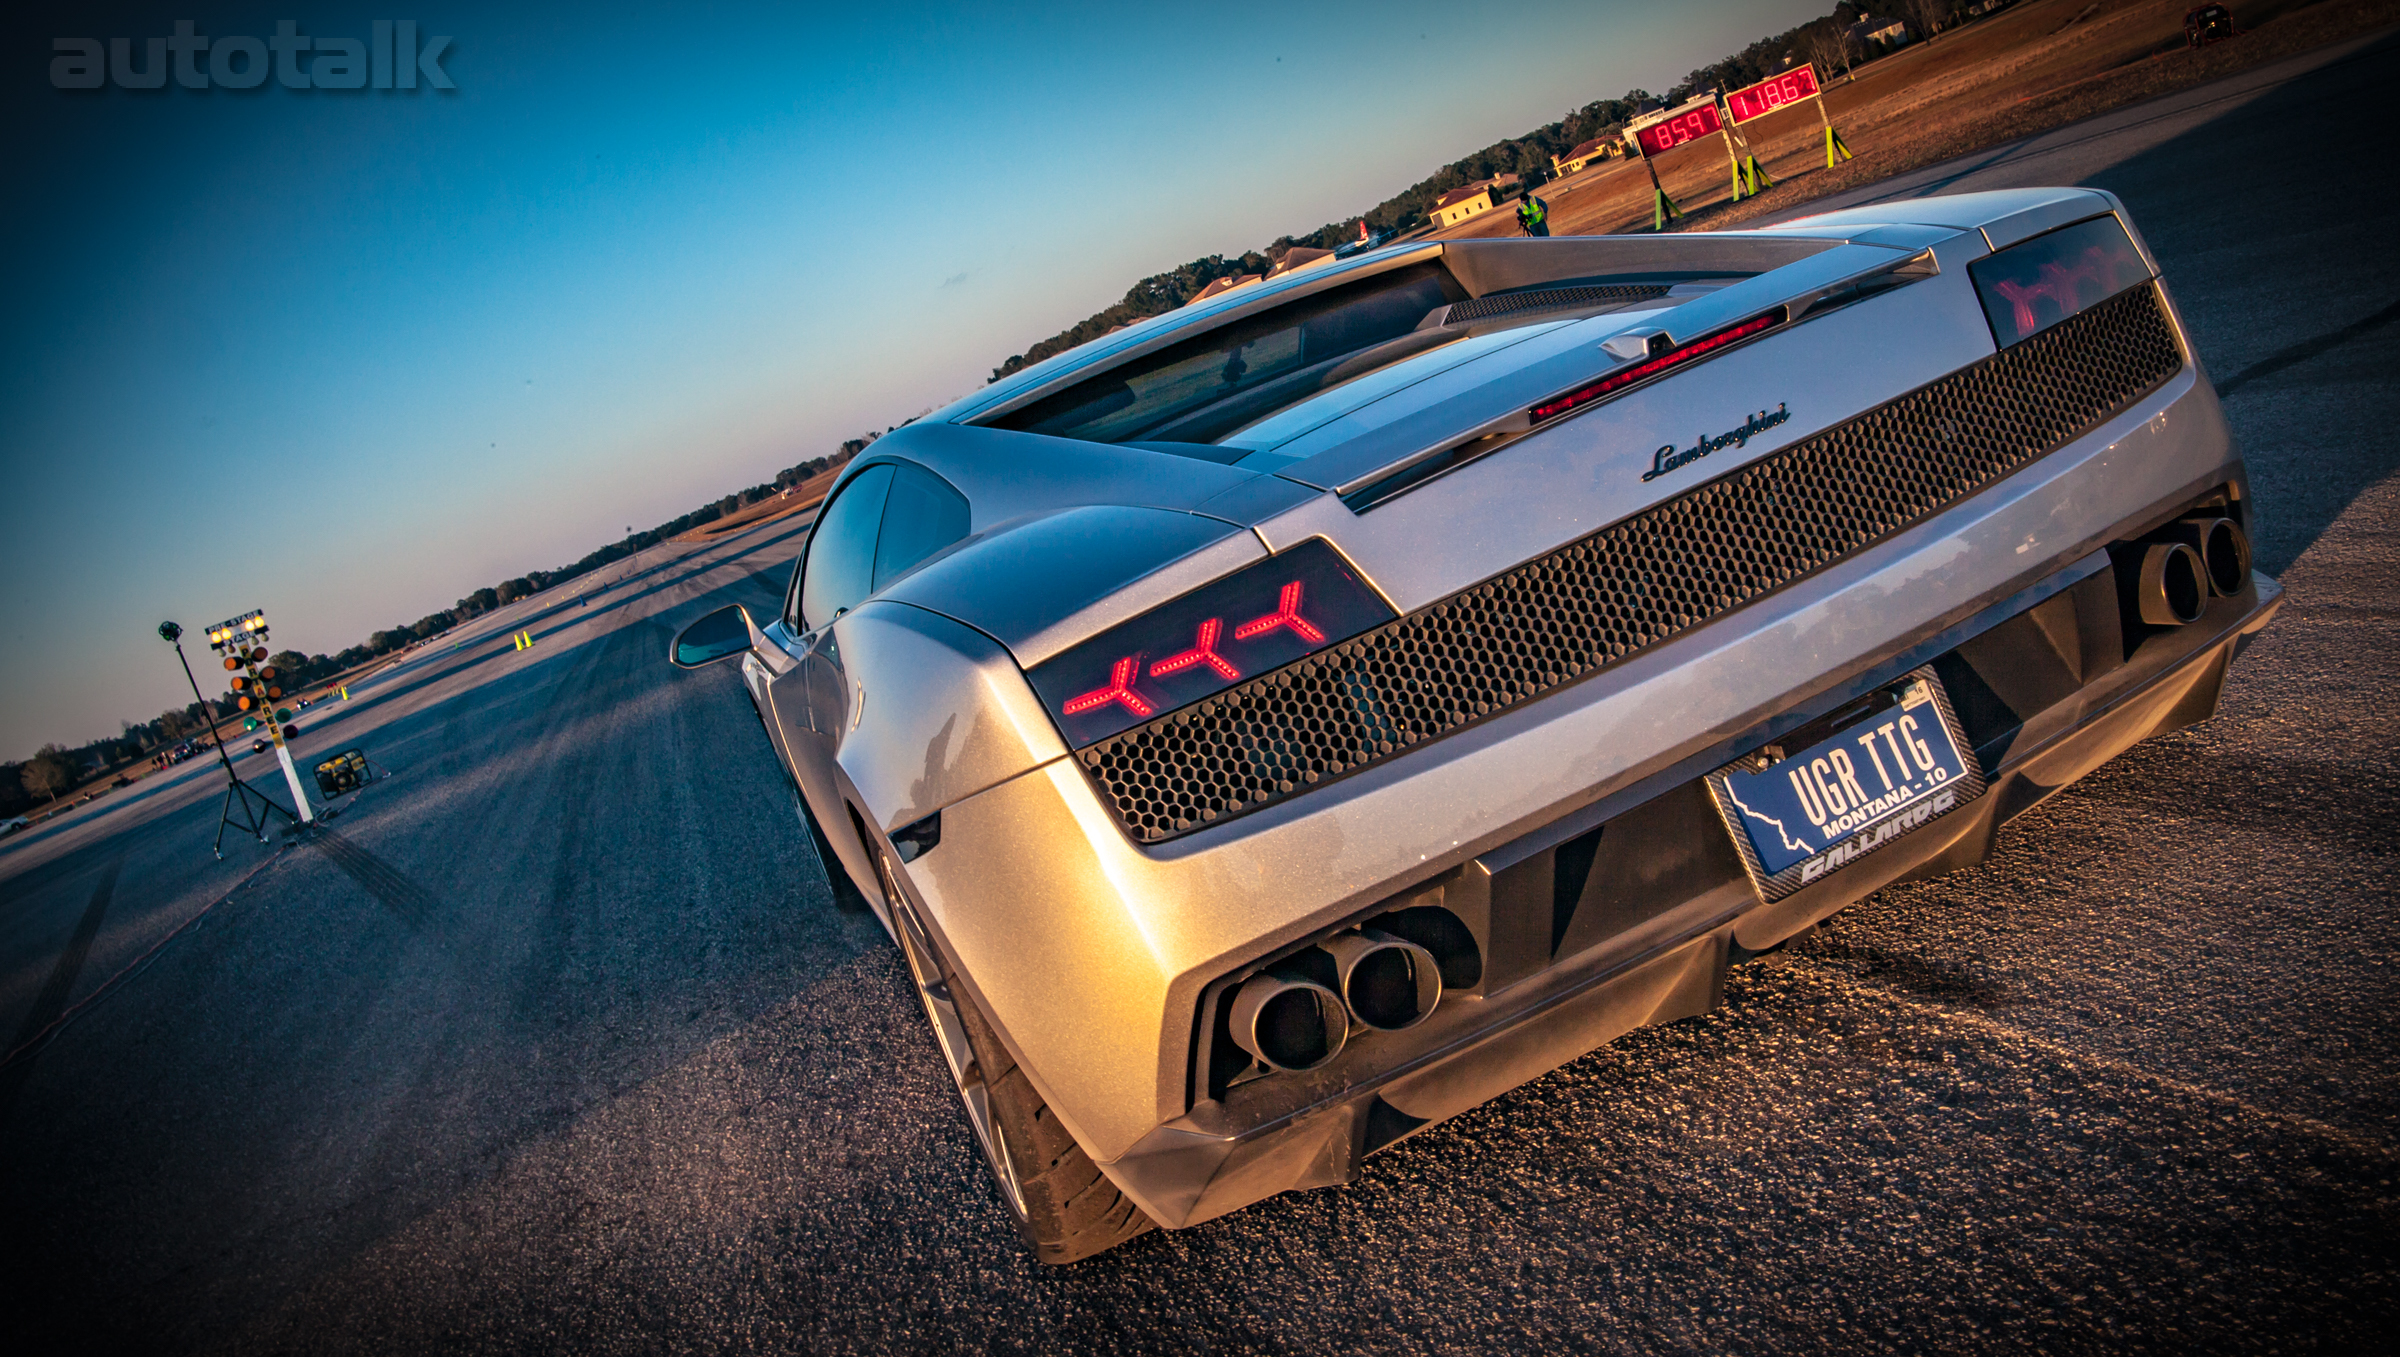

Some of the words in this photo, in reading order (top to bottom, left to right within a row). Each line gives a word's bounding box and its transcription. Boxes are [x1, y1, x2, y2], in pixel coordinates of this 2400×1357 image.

[1641, 402, 1791, 482] Lamborghini
[208, 611, 259, 633] PRE-STAGE
[1788, 748, 1869, 827] UGR
[1858, 714, 1936, 791] TTG
[1822, 787, 1914, 840] MONTANA
[1925, 767, 1947, 789] 10
